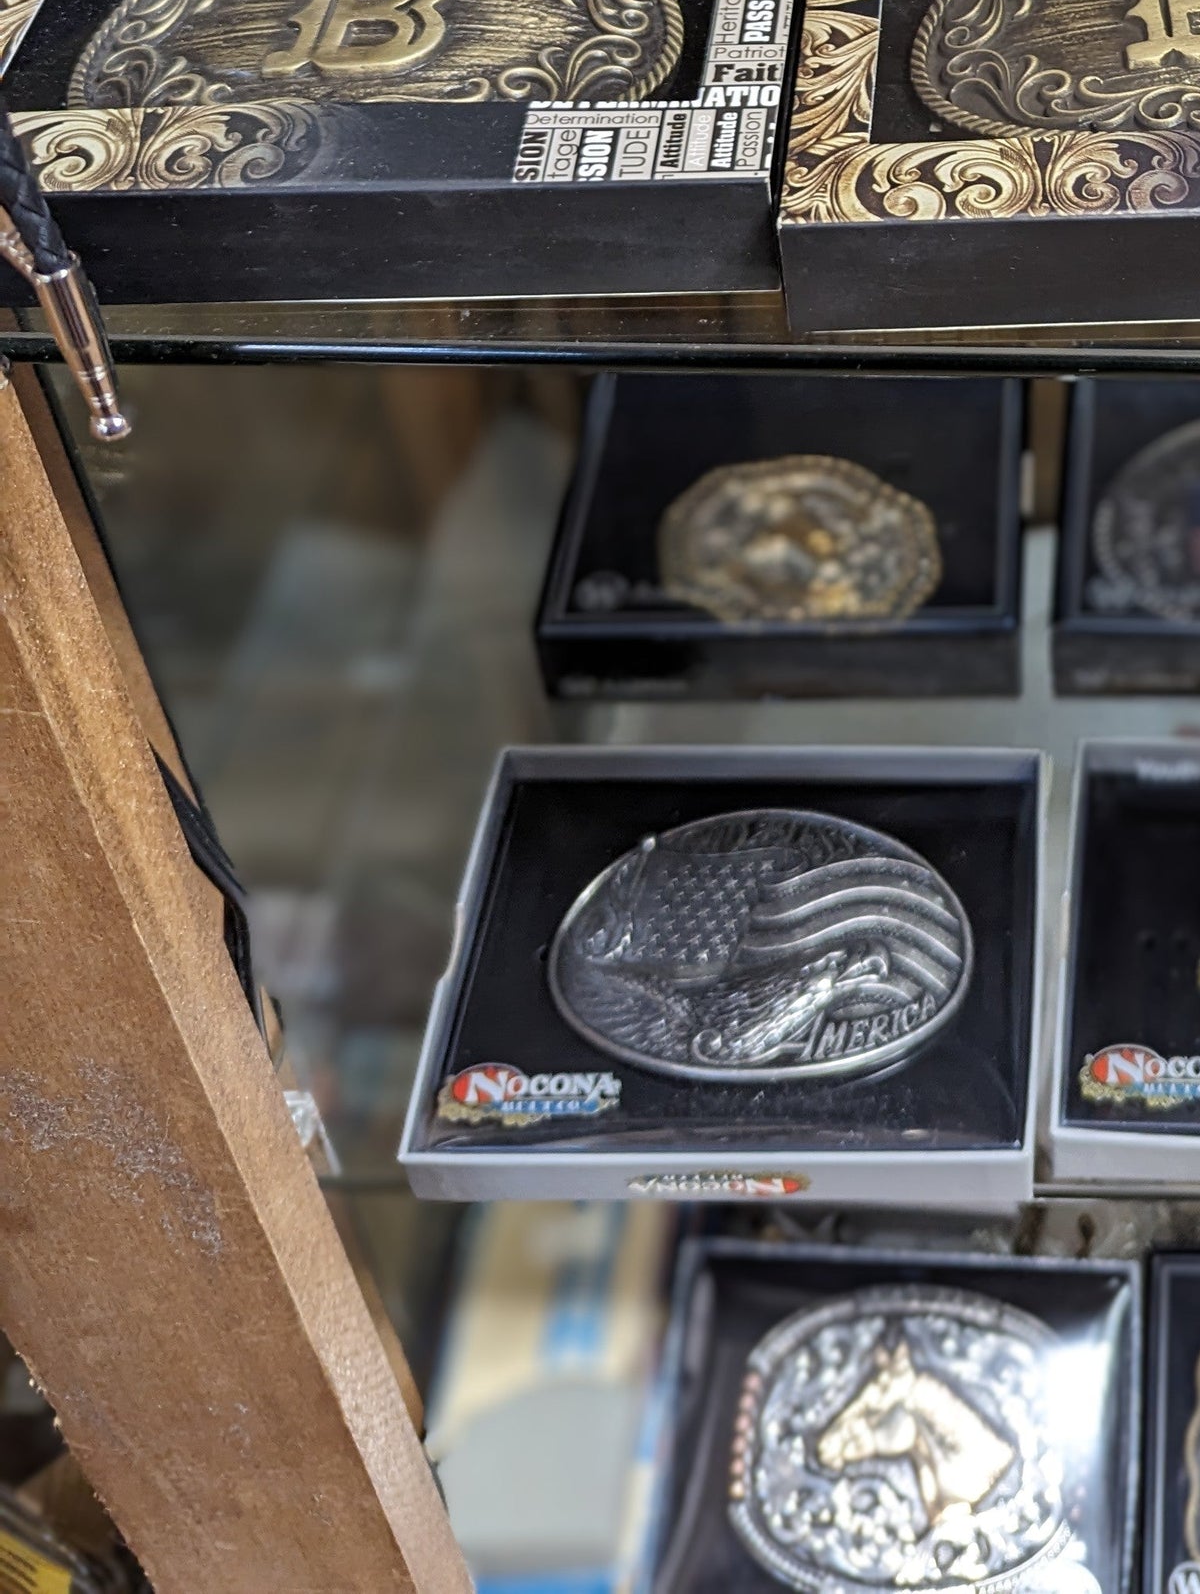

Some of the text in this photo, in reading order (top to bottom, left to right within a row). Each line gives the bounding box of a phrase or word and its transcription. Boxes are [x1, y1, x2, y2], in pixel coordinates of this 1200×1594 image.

[526, 113, 659, 125] Determination
[660, 113, 687, 168] Attitude
[711, 112, 738, 168] Attitude
[736, 111, 762, 168] Passion
[619, 129, 650, 178] TUDE
[464, 1070, 622, 1104] NOCONA
